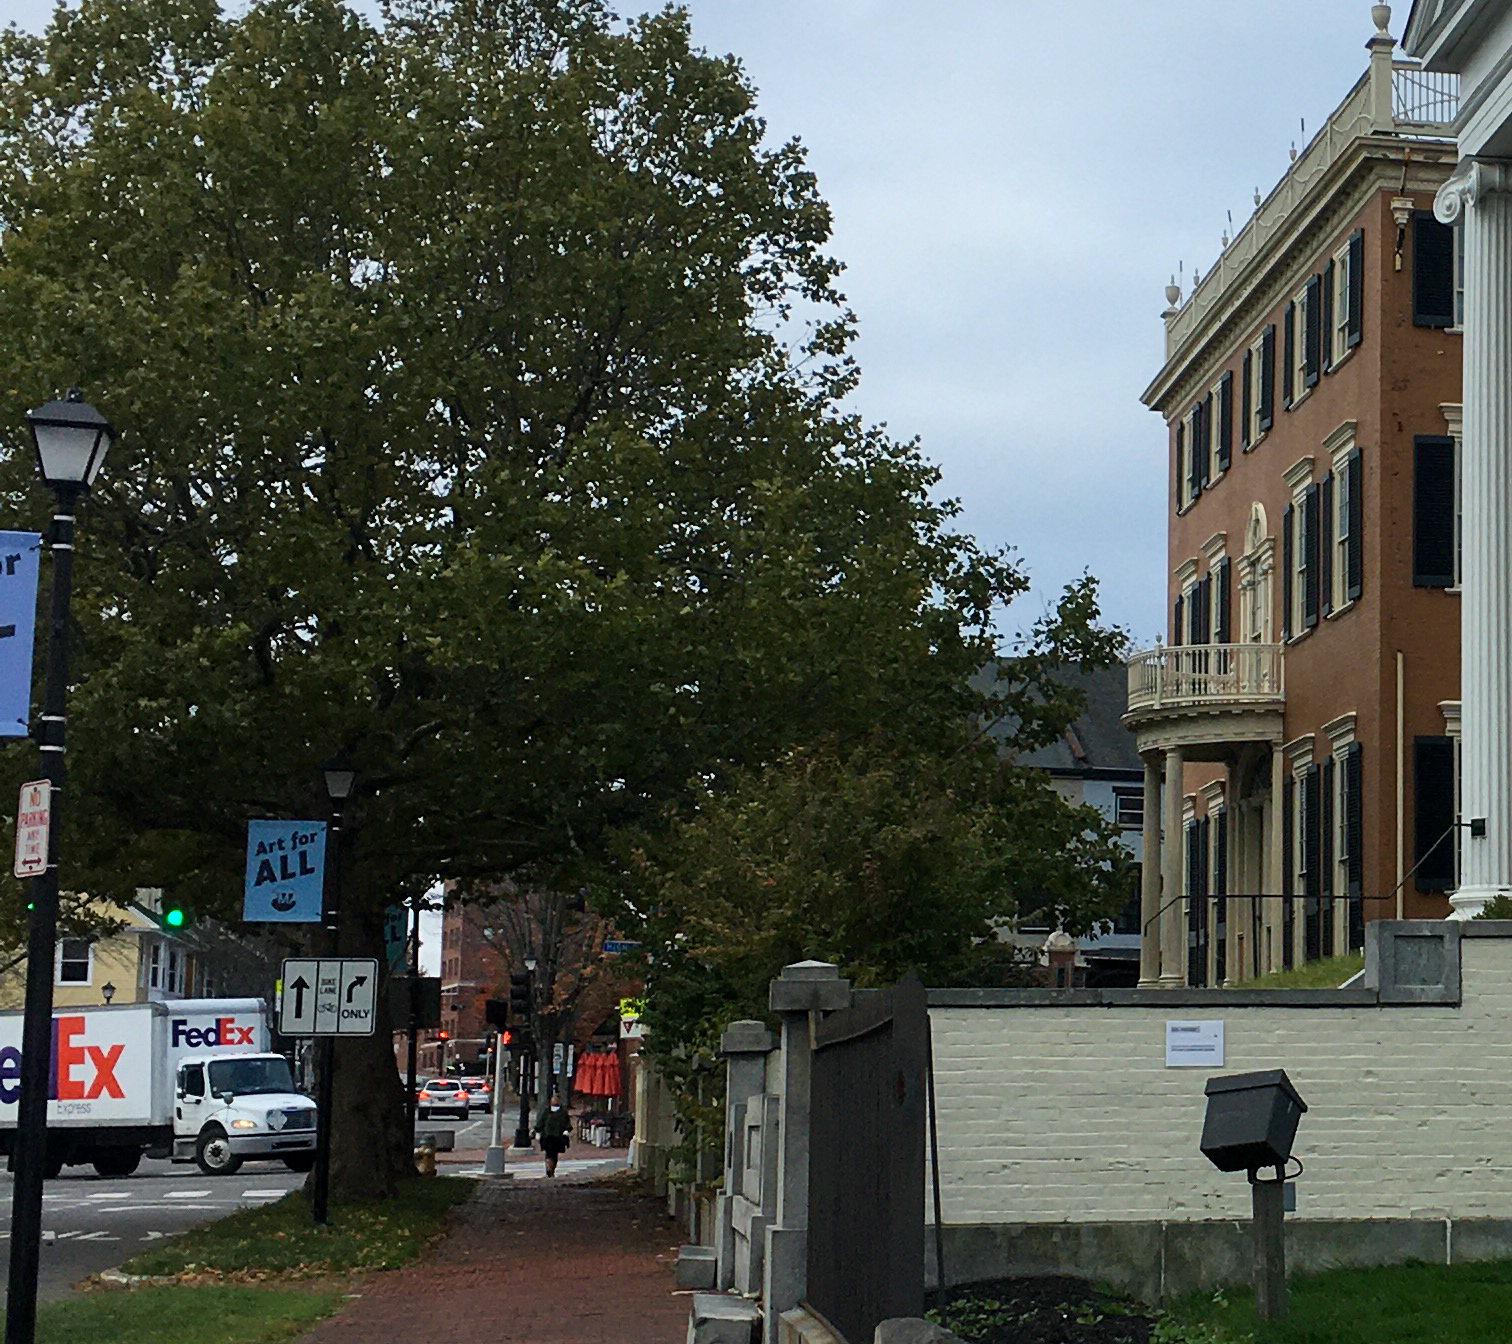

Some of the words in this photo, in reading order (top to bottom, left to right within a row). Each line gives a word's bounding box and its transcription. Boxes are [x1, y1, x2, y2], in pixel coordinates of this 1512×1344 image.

[20, 809, 48, 828] PARKING
[255, 838, 286, 856] Art
[291, 831, 318, 850] for
[254, 850, 315, 886] ALL
[341, 1009, 369, 1019] ONLY
[172, 1017, 255, 1047] FedEx
